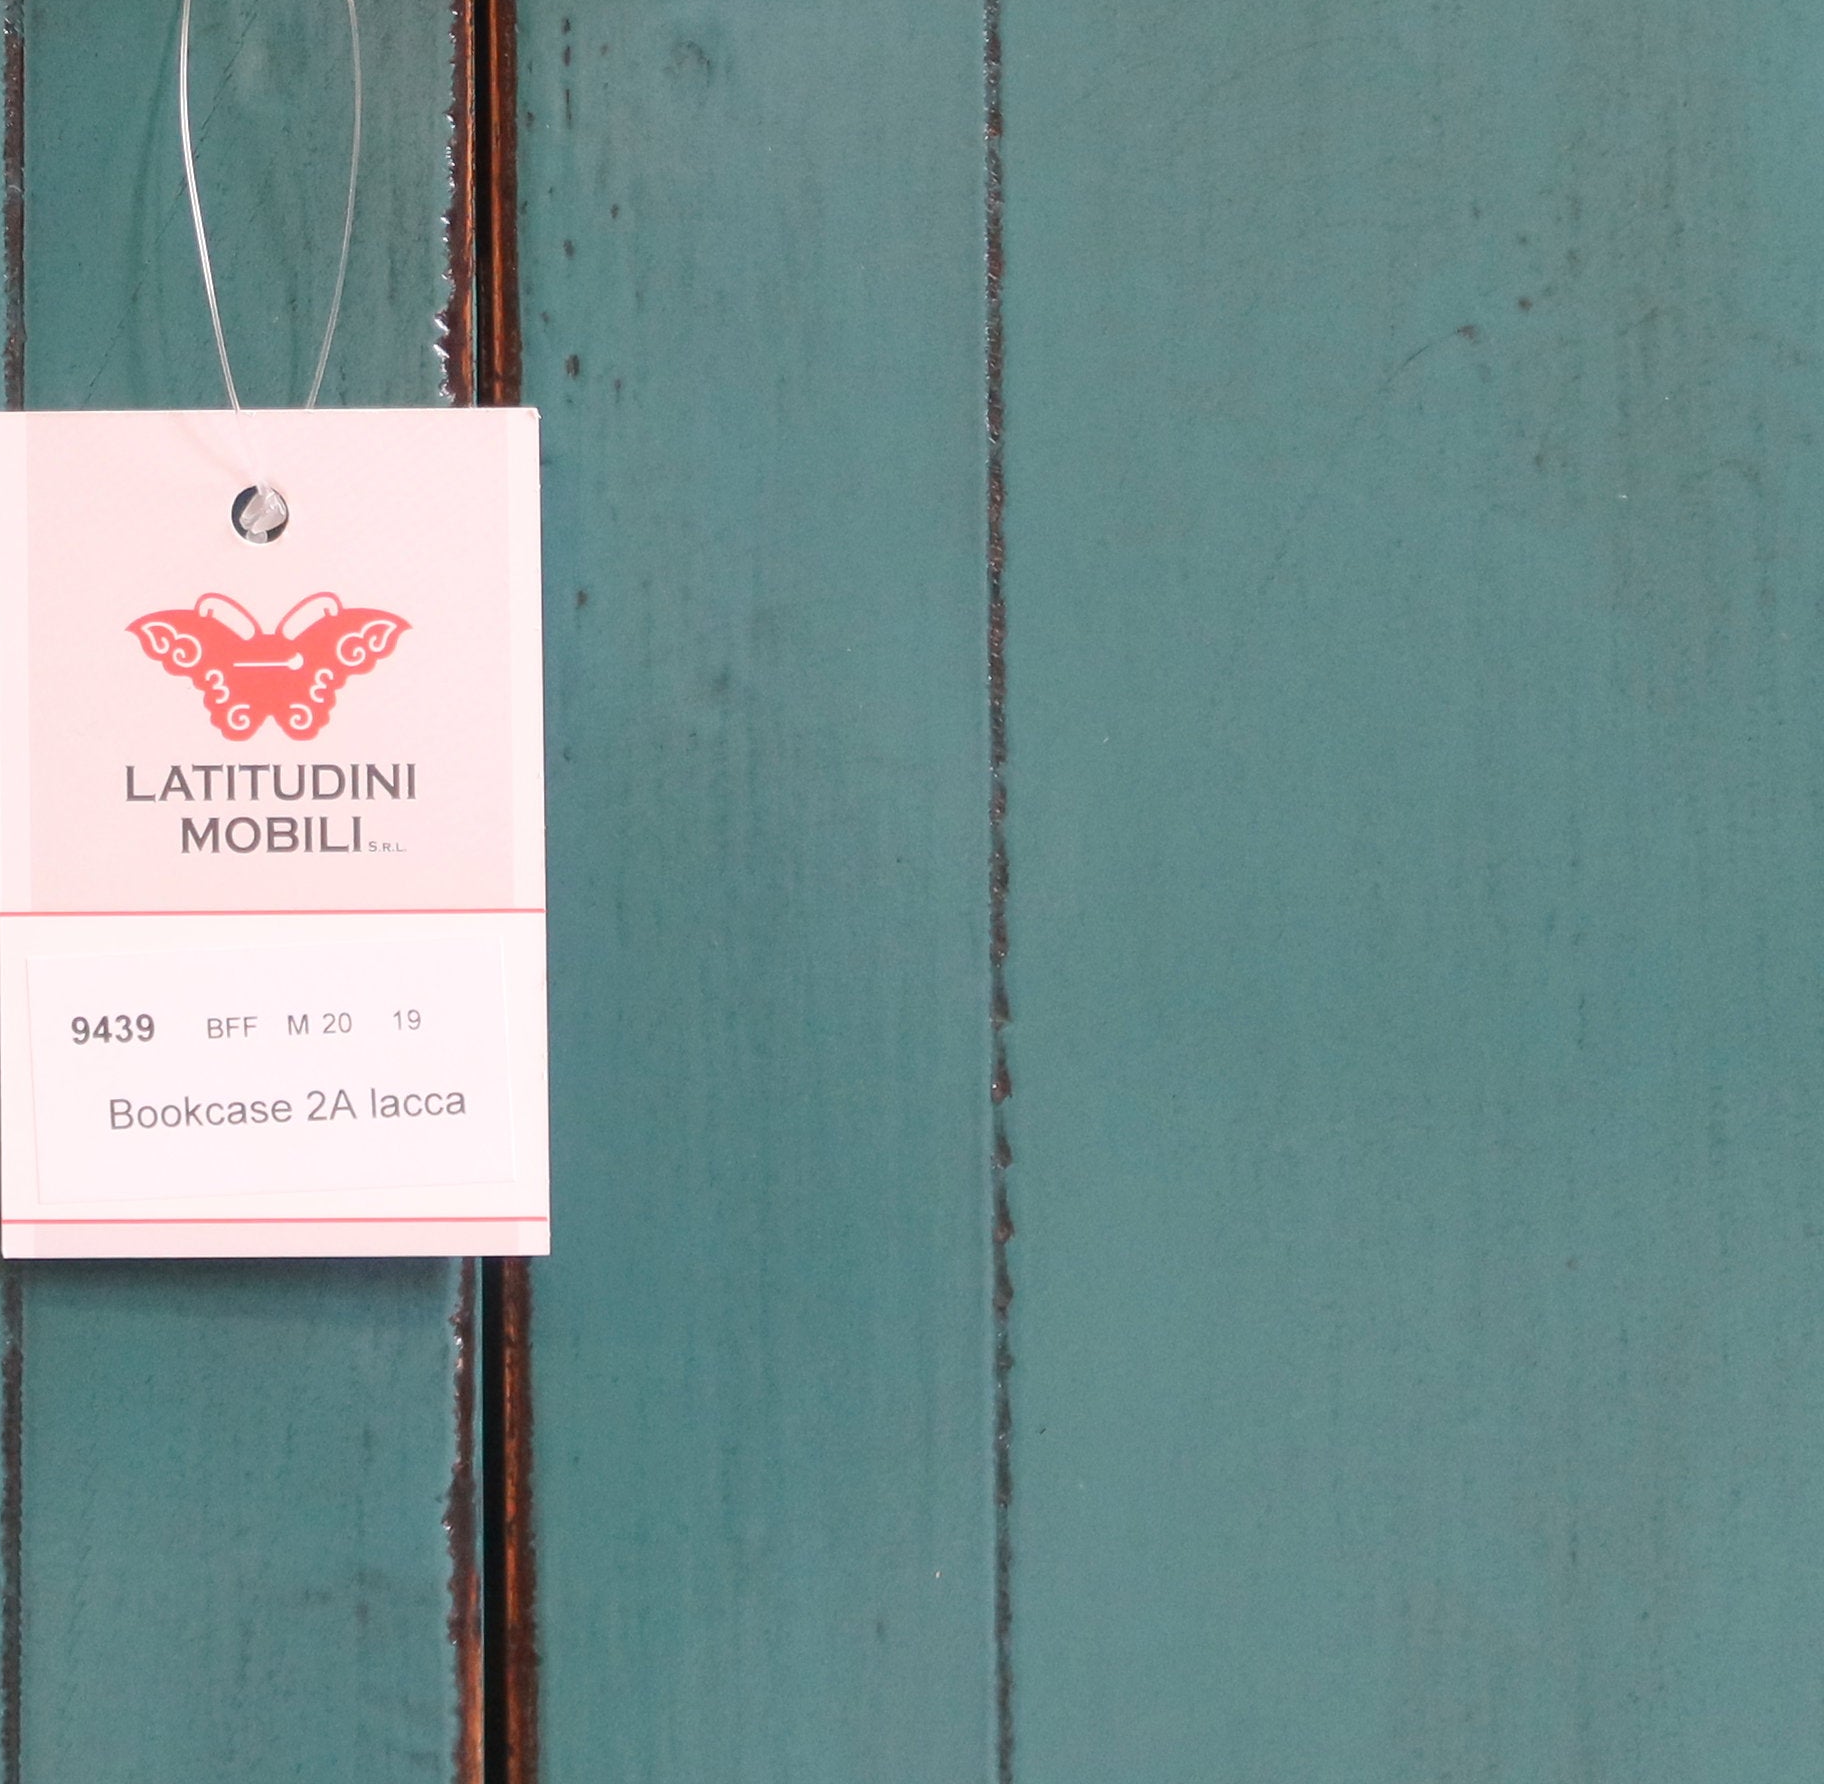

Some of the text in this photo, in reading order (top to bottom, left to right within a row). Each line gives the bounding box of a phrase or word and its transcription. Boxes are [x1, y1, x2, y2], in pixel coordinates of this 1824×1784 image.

[126, 764, 415, 802] LATITUDINI
[181, 816, 406, 853] MOBILI S.R.L.
[72, 1009, 421, 1045] 9439 BFF M 20 19
[110, 1088, 465, 1129] Bookcase 2A lacca
